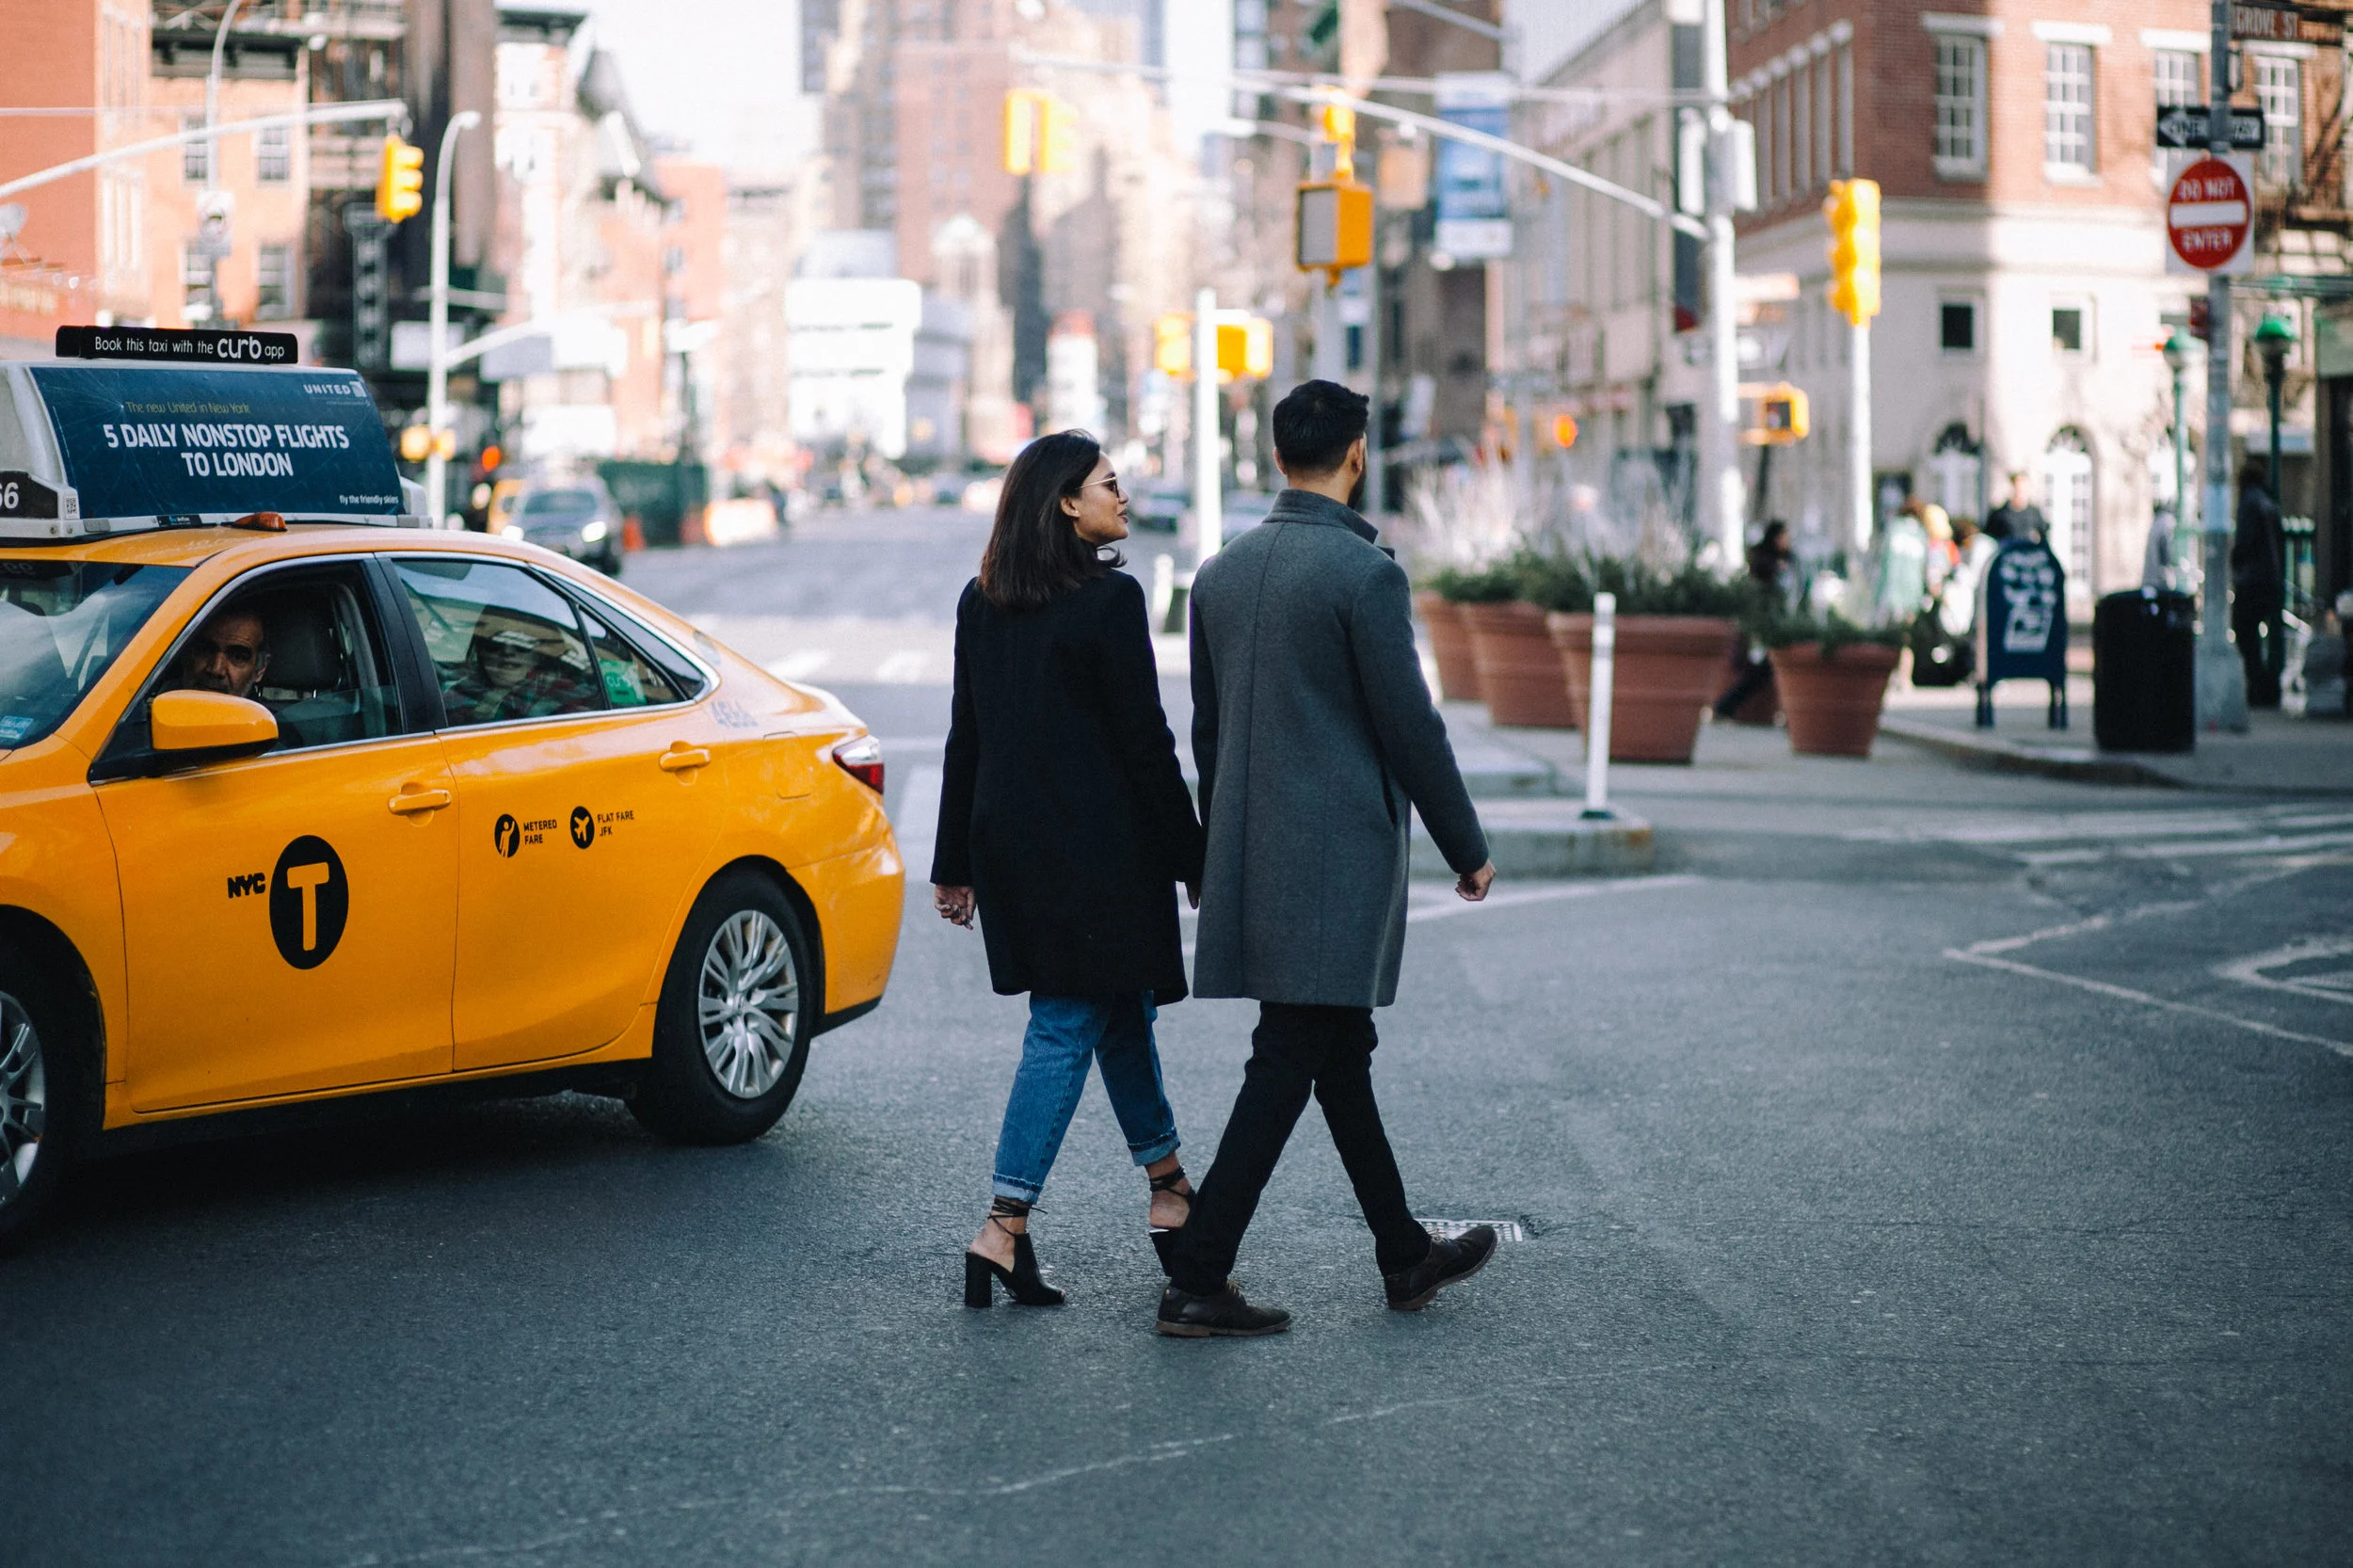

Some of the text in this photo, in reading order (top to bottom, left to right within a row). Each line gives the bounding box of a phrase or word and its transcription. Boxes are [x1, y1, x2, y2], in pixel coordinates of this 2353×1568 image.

[2179, 176, 2235, 200] DO NOT
[2182, 229, 2233, 252] ENTER
[95, 335, 285, 360] Book this taxi with the curb app
[303, 384, 352, 395] UNITED
[125, 402, 144, 413] The
[146, 403, 166, 413] new
[168, 401, 197, 413] United
[199, 402, 208, 413] in
[208, 402, 229, 414] New
[103, 424, 350, 449] 5 DAILY NONSTOP FLIGHTS
[181, 452, 295, 477] TO LONDON
[0, 481, 19, 510] 6
[340, 494, 348, 505] fly
[349, 494, 360, 504] the
[360, 494, 383, 505] friendly
[523, 819, 558, 832] METERED
[597, 809, 634, 824] FLAT FARE
[524, 834, 544, 845] FARE
[600, 825, 613, 837] JFK
[227, 861, 329, 952] NYC T
